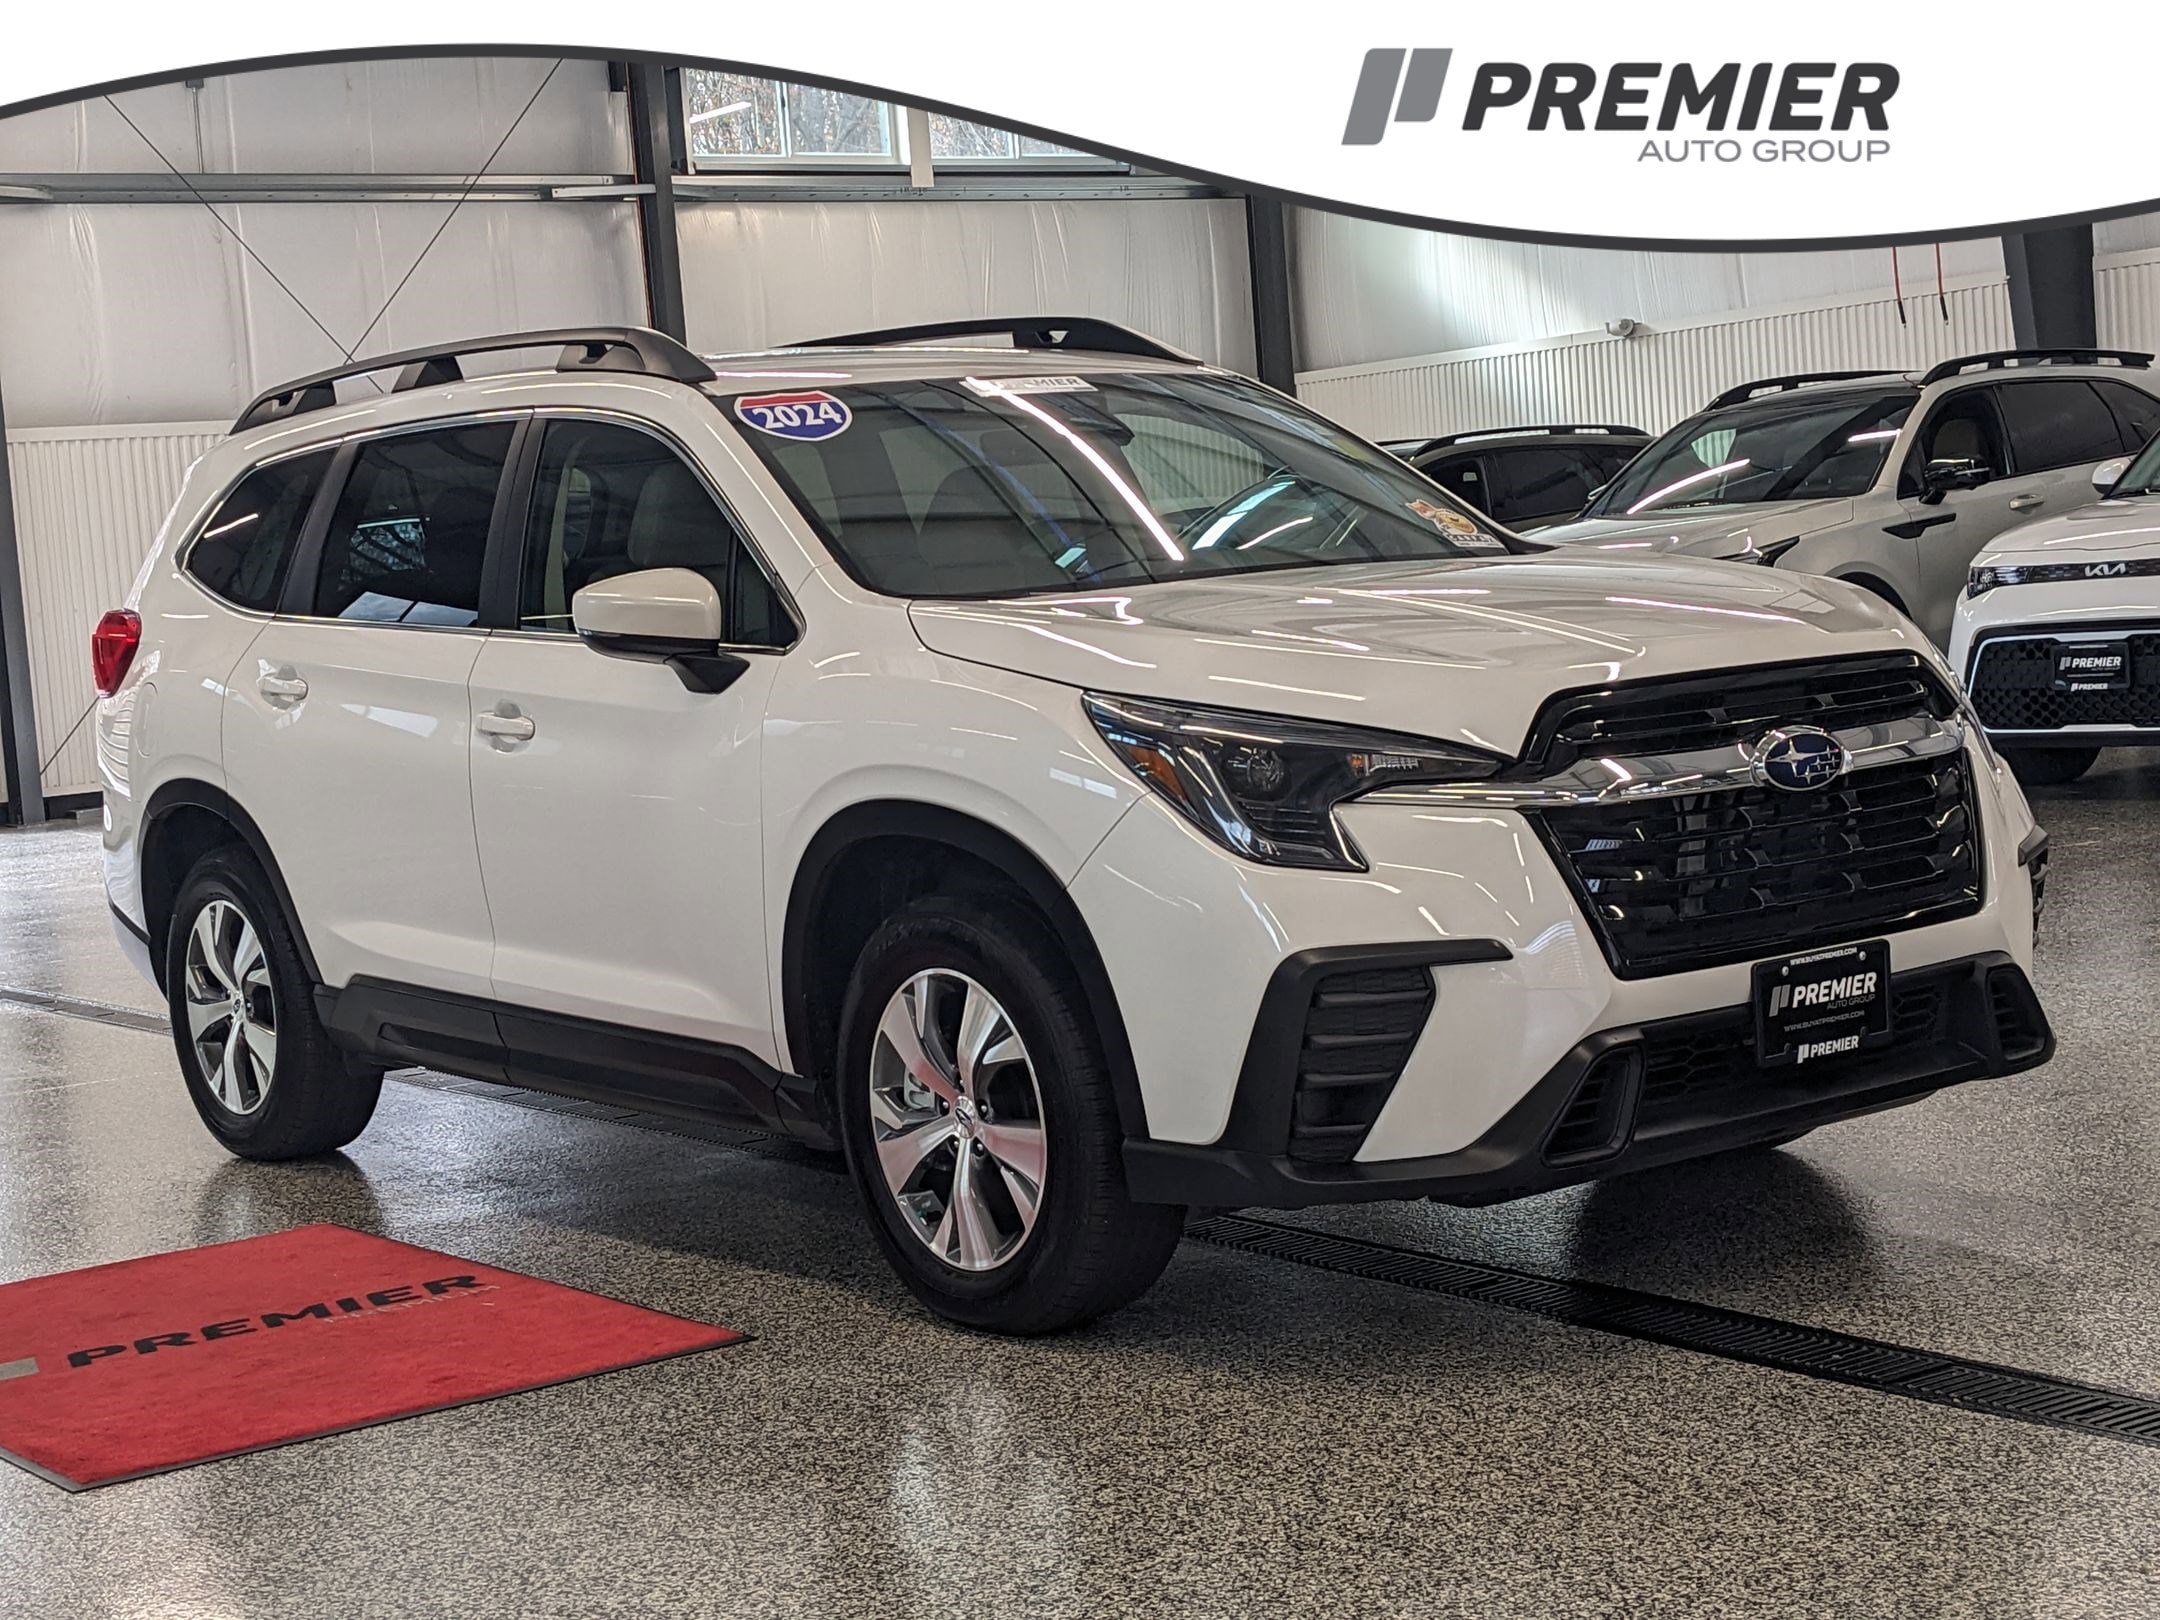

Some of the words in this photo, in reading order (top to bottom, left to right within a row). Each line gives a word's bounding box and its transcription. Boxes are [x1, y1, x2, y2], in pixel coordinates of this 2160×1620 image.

[752, 402, 843, 429] 2024
[2084, 562, 2126, 577] KIA
[2071, 656, 2121, 668] PREMIER
[1792, 971, 1877, 1008] PREMIER
[1826, 1000, 1848, 1010] AUTO
[1849, 993, 1876, 1006] GROUP
[1810, 1035, 1859, 1058] PREMIER
[67, 1275, 486, 1369] PREMIER
